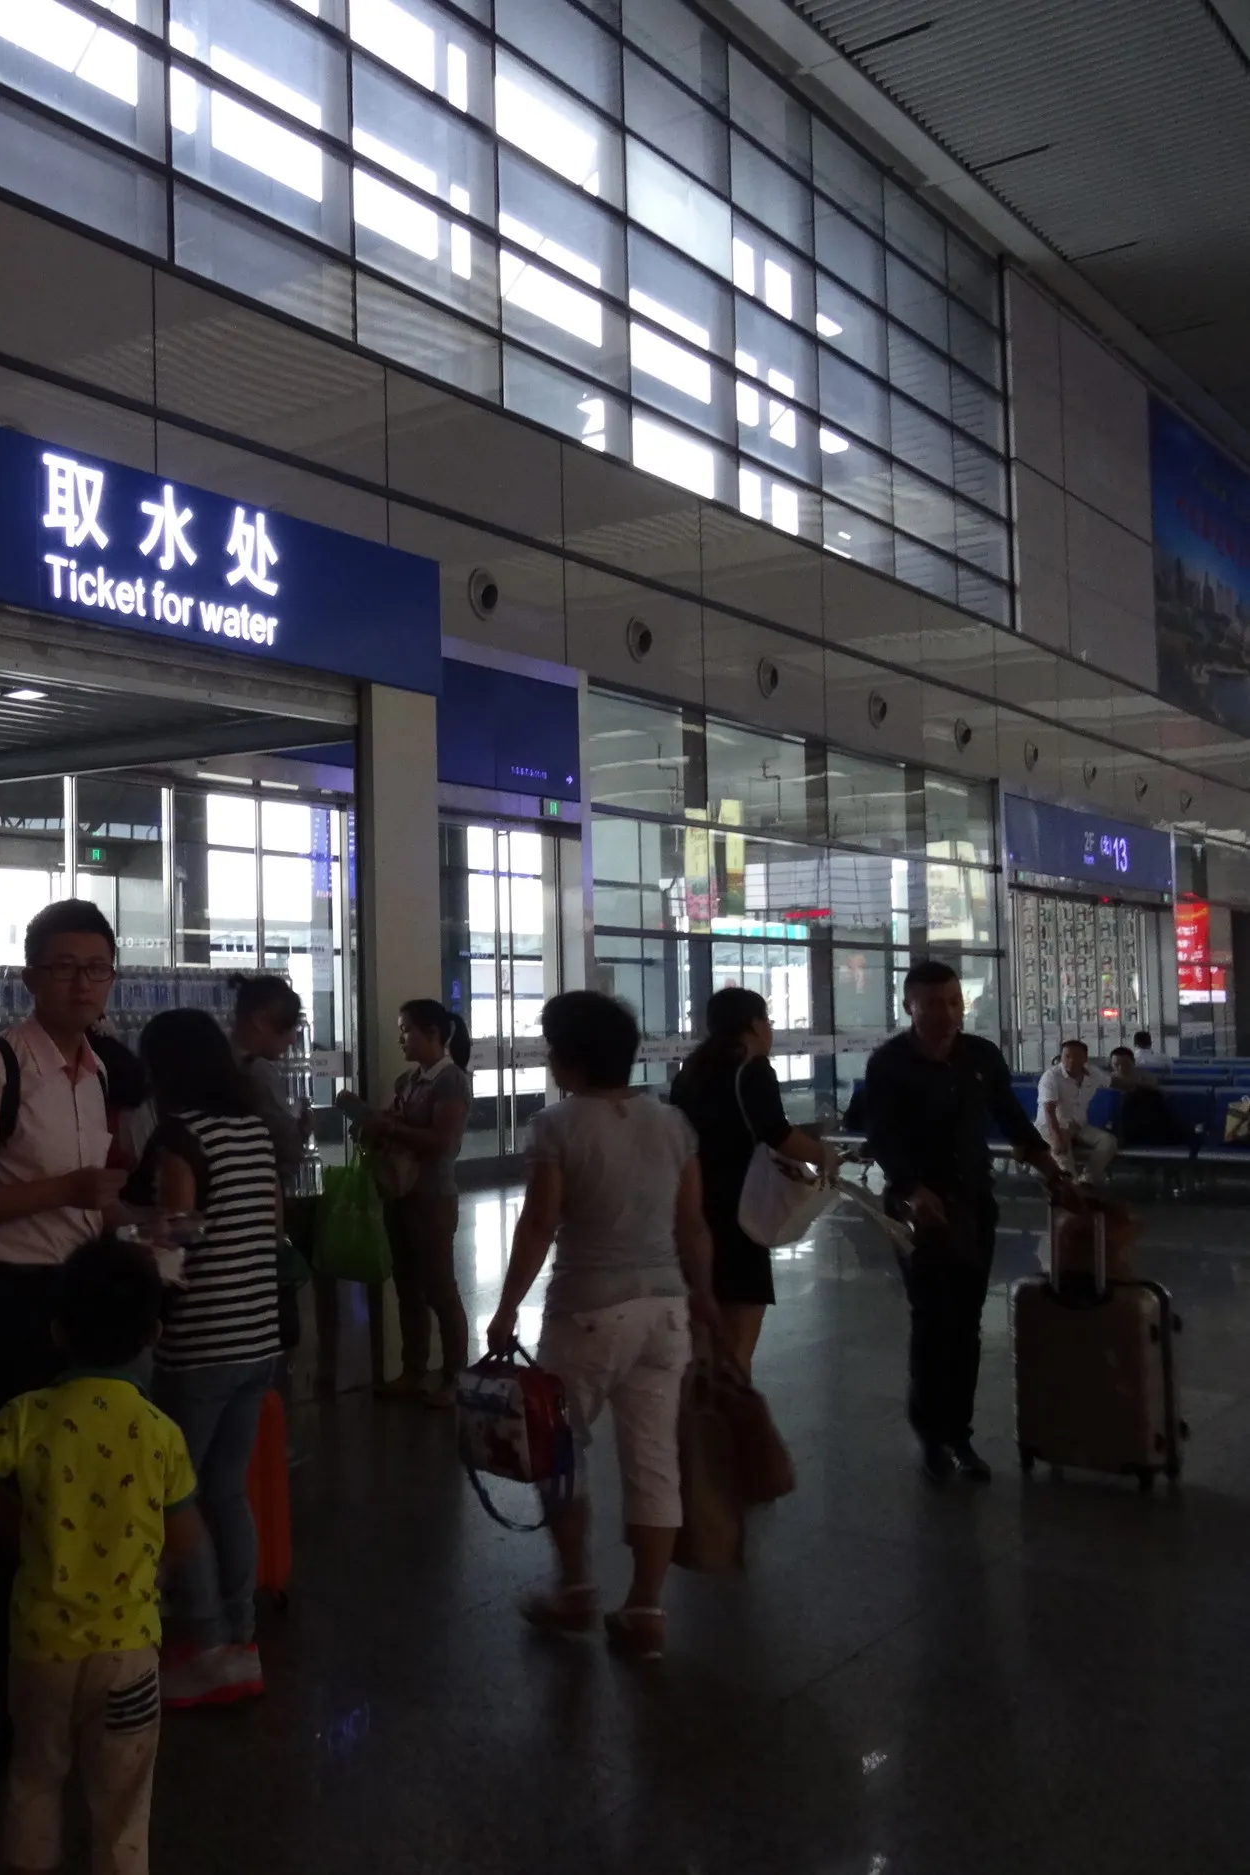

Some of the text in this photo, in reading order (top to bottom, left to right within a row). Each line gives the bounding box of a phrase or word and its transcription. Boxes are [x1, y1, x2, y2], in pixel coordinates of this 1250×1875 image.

[41, 452, 279, 597] 取水处
[43, 553, 280, 646] Ticket for water
